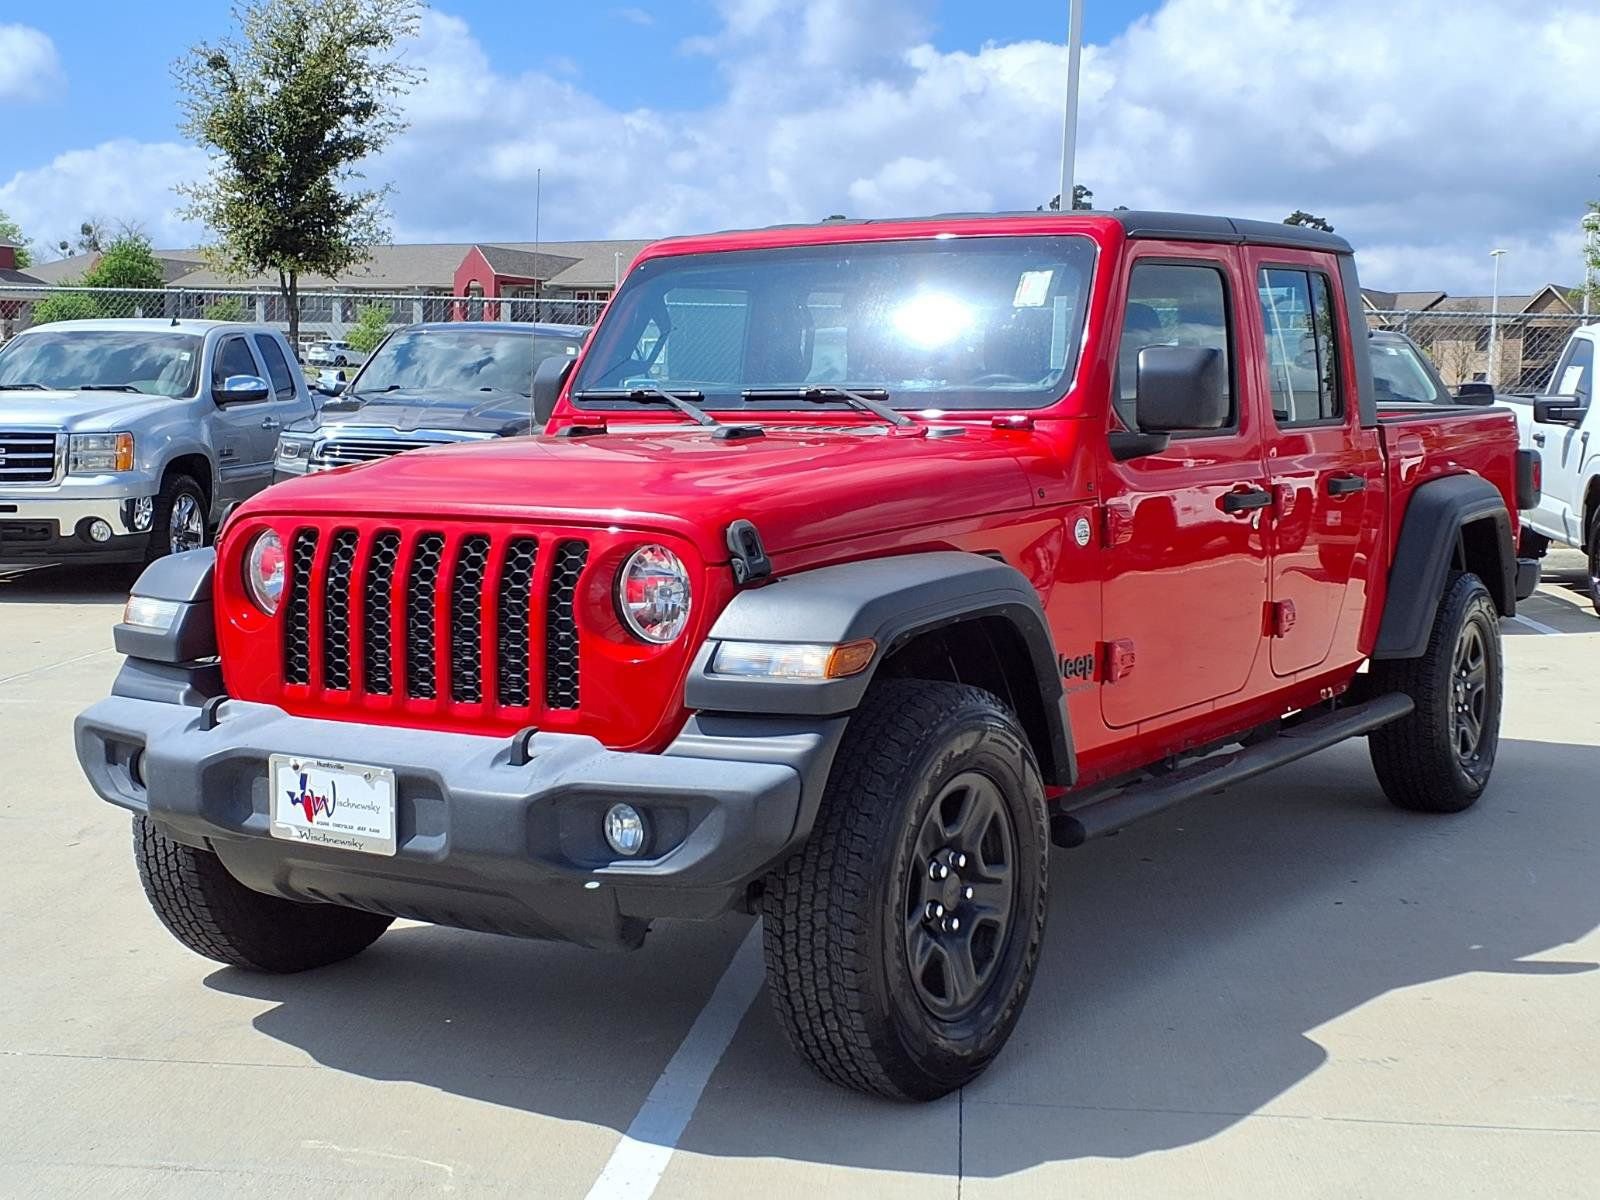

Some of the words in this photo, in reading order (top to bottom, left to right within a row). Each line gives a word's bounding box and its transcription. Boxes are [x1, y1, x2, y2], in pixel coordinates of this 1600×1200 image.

[1058, 652, 1096, 680] Jeep
[316, 760, 345, 770] Huntsville
[308, 780, 381, 818] Wischnewsky
[298, 829, 364, 850] Wischnewsky
